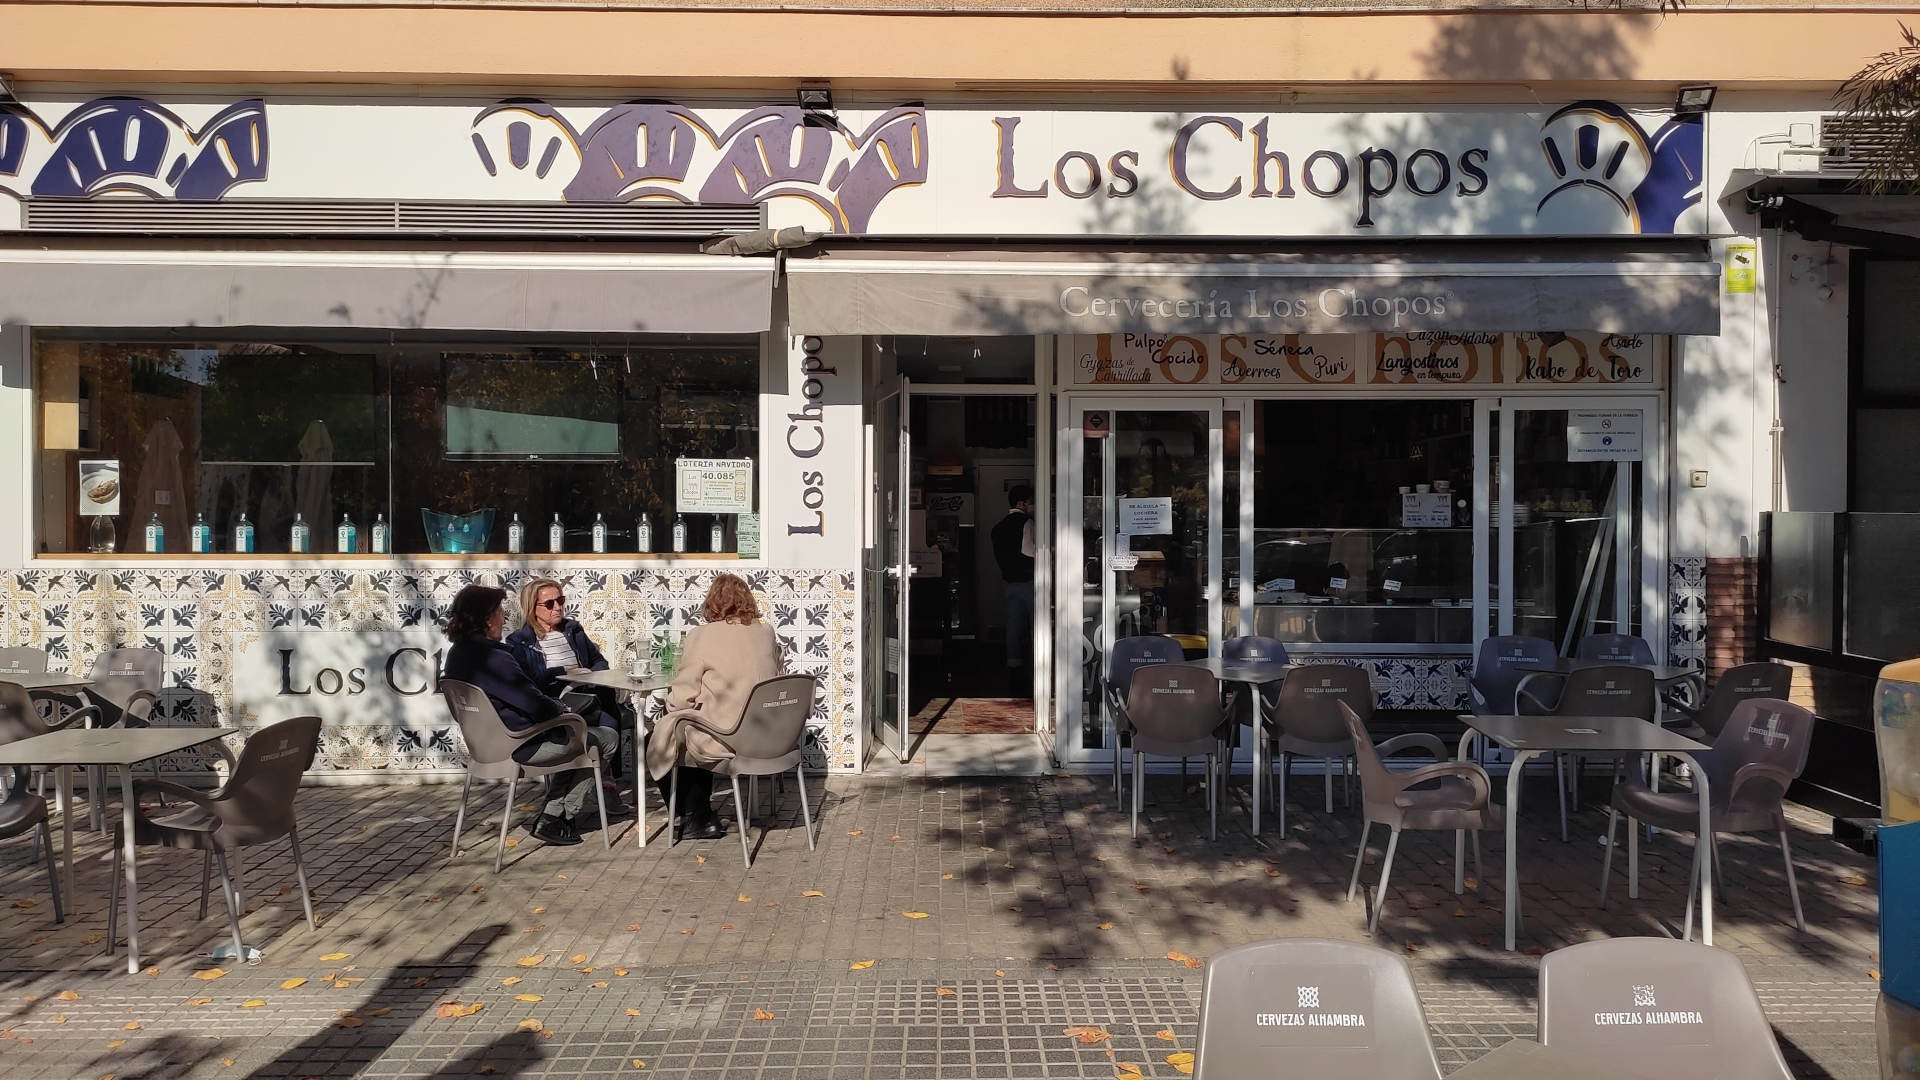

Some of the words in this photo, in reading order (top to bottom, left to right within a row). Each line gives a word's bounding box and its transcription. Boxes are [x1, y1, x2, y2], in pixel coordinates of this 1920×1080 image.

[991, 116, 1139, 199] Los
[1169, 115, 1489, 228] Chopos
[1060, 286, 1233, 319] Cervecería
[1248, 289, 1307, 319] Los
[1318, 288, 1445, 327] Chopos
[1123, 332, 1168, 353] Pulpo
[1254, 339, 1314, 356] Séneca
[1151, 349, 1205, 365] Cocido
[1223, 357, 1281, 379] Averroes
[1313, 355, 1348, 379] Puri
[1376, 351, 1459, 376] Langostinos
[1525, 355, 1567, 380] Rabo
[1575, 356, 1600, 378] de
[1608, 355, 1647, 380] Toro
[787, 335, 837, 459] Chopo
[702, 472, 735, 480] 40.085
[715, 460, 751, 469] NAVIDAD
[788, 471, 824, 537] Los
[278, 648, 366, 696] Los
[1256, 1013, 1305, 1026] CERVEZAS
[1308, 1013, 1366, 1027] ALHAMBRA
[1594, 1012, 1643, 1025] CERVEZAS
[1645, 1011, 1704, 1025] ALHAMBRA
